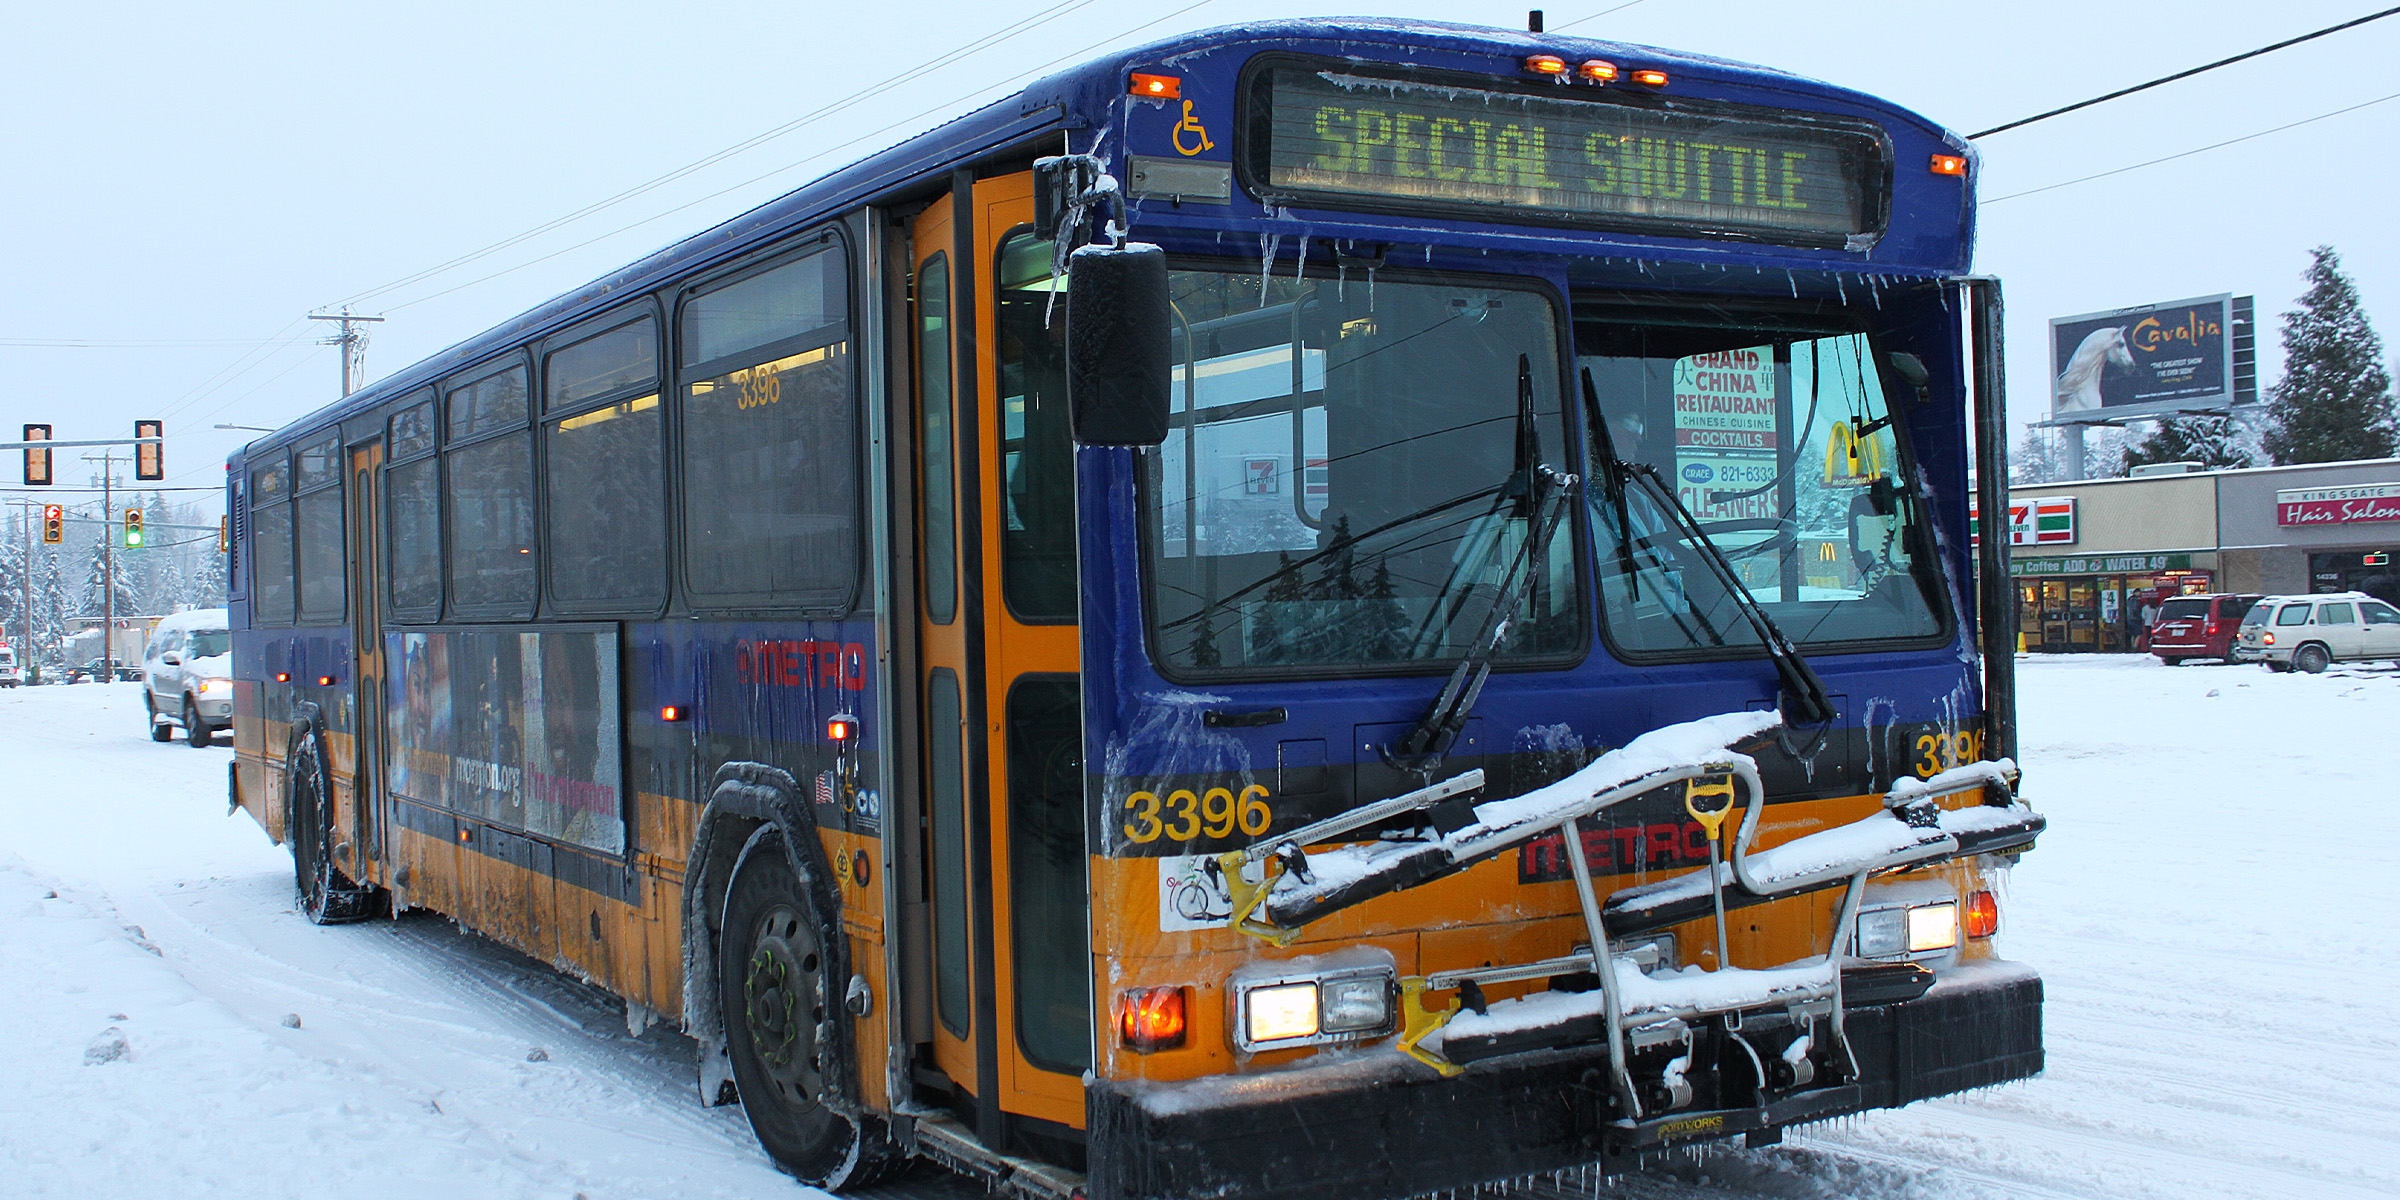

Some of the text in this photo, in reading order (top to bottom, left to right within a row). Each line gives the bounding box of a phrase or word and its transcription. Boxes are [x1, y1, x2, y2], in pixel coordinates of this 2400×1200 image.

[1315, 106, 1807, 209] SPECIAL SHUTTLE
[2132, 310, 2222, 352] Cavalia
[1692, 348, 1760, 371] GRAND
[736, 364, 781, 410] 3396
[1695, 371, 1757, 394] CHINA
[1675, 393, 1776, 416] RESTAURANT
[1682, 415, 1771, 429] CHINESE CUISINE
[1691, 430, 1763, 448] COCKTAILS
[1685, 465, 1775, 482] GRACE 821-6333
[2301, 487, 2385, 501] KINGSGATE
[2286, 500, 2400, 524] Hair Salon
[2026, 560, 2060, 572] Coffee
[2063, 559, 2088, 573] ADD
[2106, 557, 2147, 572] WATER
[752, 640, 867, 692] METRO
[455, 756, 522, 808] mormon.org
[1124, 784, 1273, 844] 3396
[1525, 822, 1711, 876] METRO
